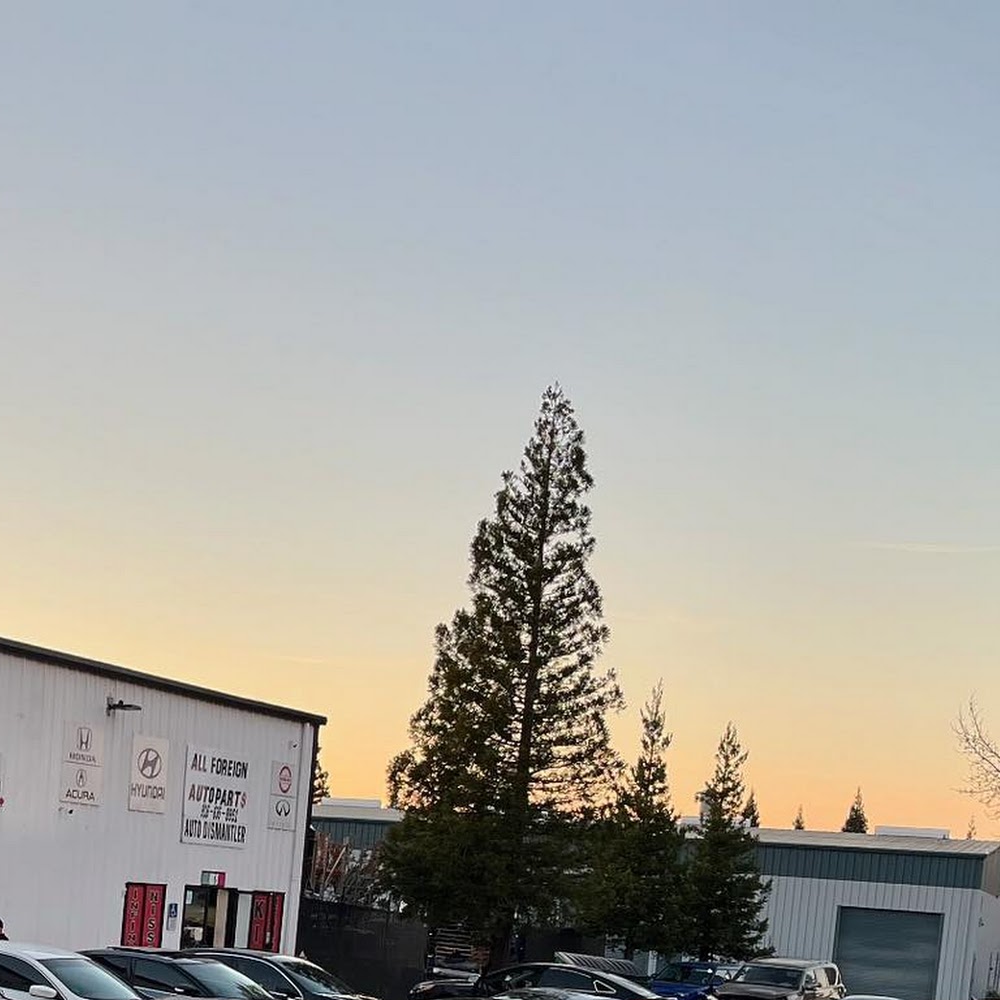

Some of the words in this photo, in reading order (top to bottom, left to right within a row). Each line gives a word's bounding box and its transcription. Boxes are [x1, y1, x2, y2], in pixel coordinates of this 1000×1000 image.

[69, 752, 96, 763] HONDA
[191, 753, 207, 772] ALL
[210, 757, 249, 779] FOREIGN
[66, 788, 95, 801] ACURA
[184, 818, 201, 838] AUTO
[202, 821, 246, 843] DISMANTLER
[147, 890, 159, 947] NISS
[252, 899, 266, 946] KI
